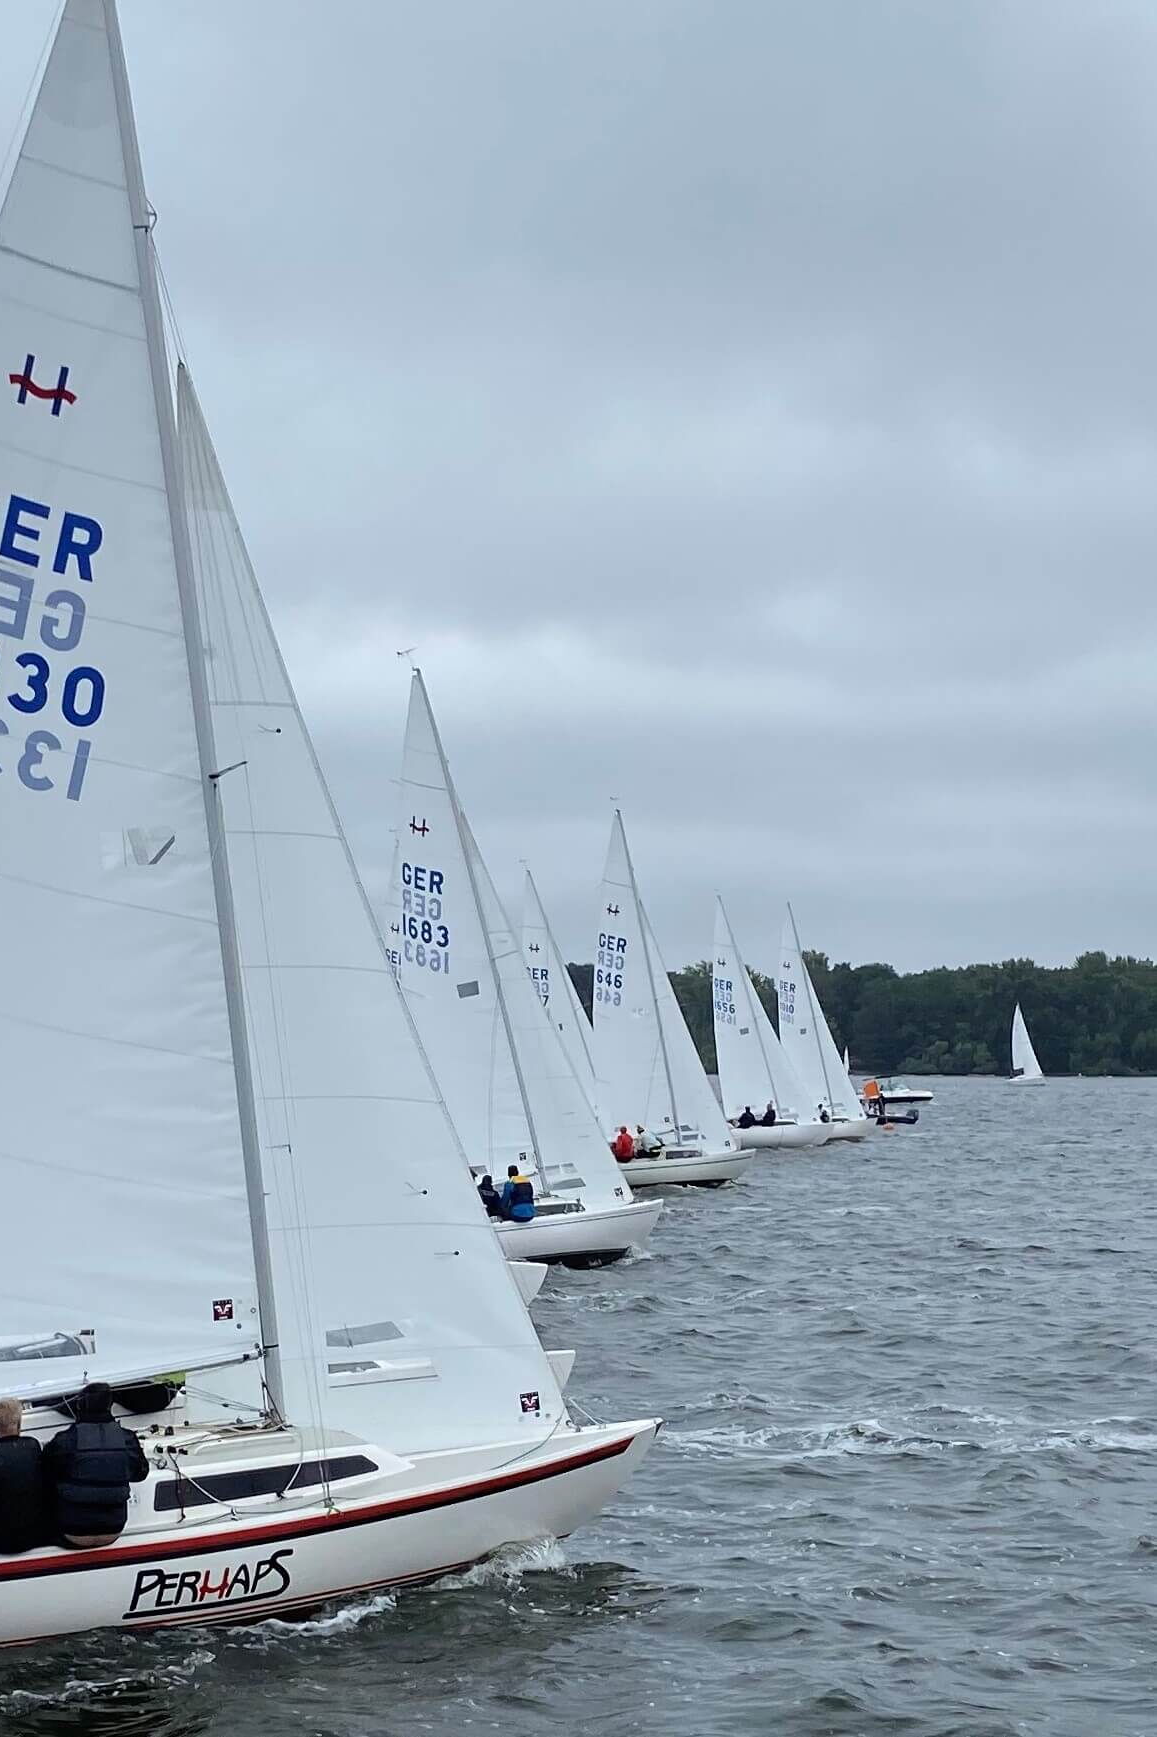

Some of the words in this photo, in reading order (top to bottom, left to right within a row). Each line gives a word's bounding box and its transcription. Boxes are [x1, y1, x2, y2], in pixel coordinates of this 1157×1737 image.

[402, 862, 444, 895] GER
[402, 913, 449, 948] 1683
[598, 933, 627, 953] GER
[526, 967, 549, 981] ER
[596, 969, 623, 989] 646
[714, 978, 733, 992] GER
[122, 1549, 294, 1620] PERHAPS
